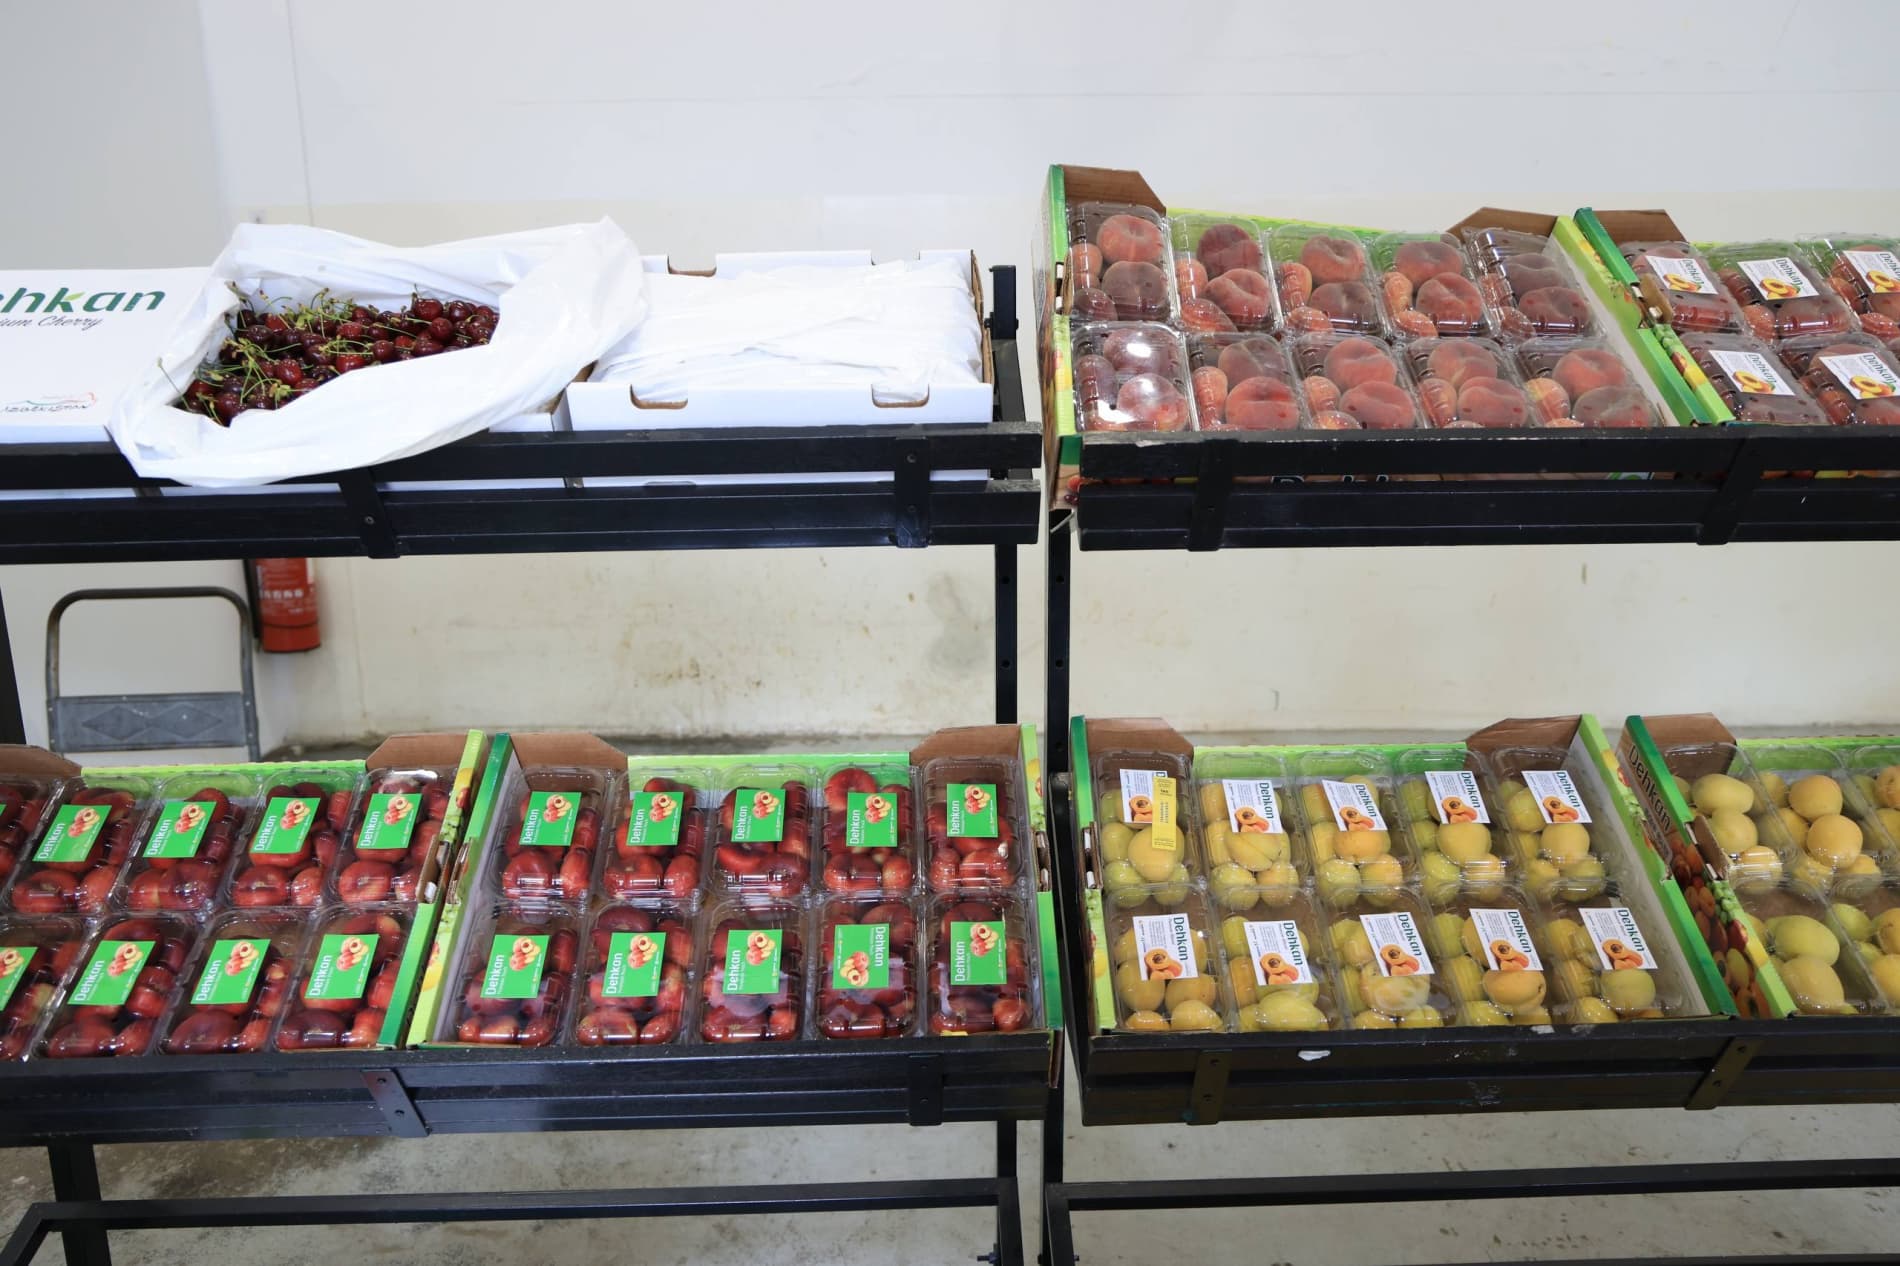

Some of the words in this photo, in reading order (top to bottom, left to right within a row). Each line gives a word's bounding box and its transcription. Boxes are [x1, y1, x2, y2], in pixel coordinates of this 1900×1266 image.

[0, 287, 166, 313] hkan
[38, 315, 103, 331] Cherry
[1259, 782, 1275, 819] Dehkan
[1355, 784, 1377, 817] Dehkan
[1460, 772, 1481, 808] Dehkan
[1556, 771, 1580, 808] Dehkan
[1628, 745, 1672, 832] Dehkan
[254, 815, 278, 851] Dehkan
[360, 810, 381, 847] Dehkan
[522, 808, 540, 843] Dehkan
[630, 808, 645, 843] Dehkan
[735, 805, 748, 840] Dehkan
[849, 809, 861, 844] Dehkan
[950, 800, 960, 834] Dehkan
[38, 822, 66, 859] Dehkan
[147, 818, 172, 855] Dehkan
[875, 926, 886, 967] Dehkan
[1173, 917, 1189, 961] Dehkan
[1283, 922, 1303, 965] Dehkan
[1398, 914, 1422, 956] Dehkan
[1508, 911, 1532, 953] Dehkan
[1618, 909, 1645, 952] Dehkan
[196, 959, 222, 1001] Dehkan
[309, 954, 332, 996] Dehkan
[485, 954, 505, 995] Dehkan
[606, 952, 623, 994] Dehkan
[727, 950, 741, 991] Dehkan
[954, 941, 966, 982] Dehkan
[74, 960, 104, 1001] Dehkan
